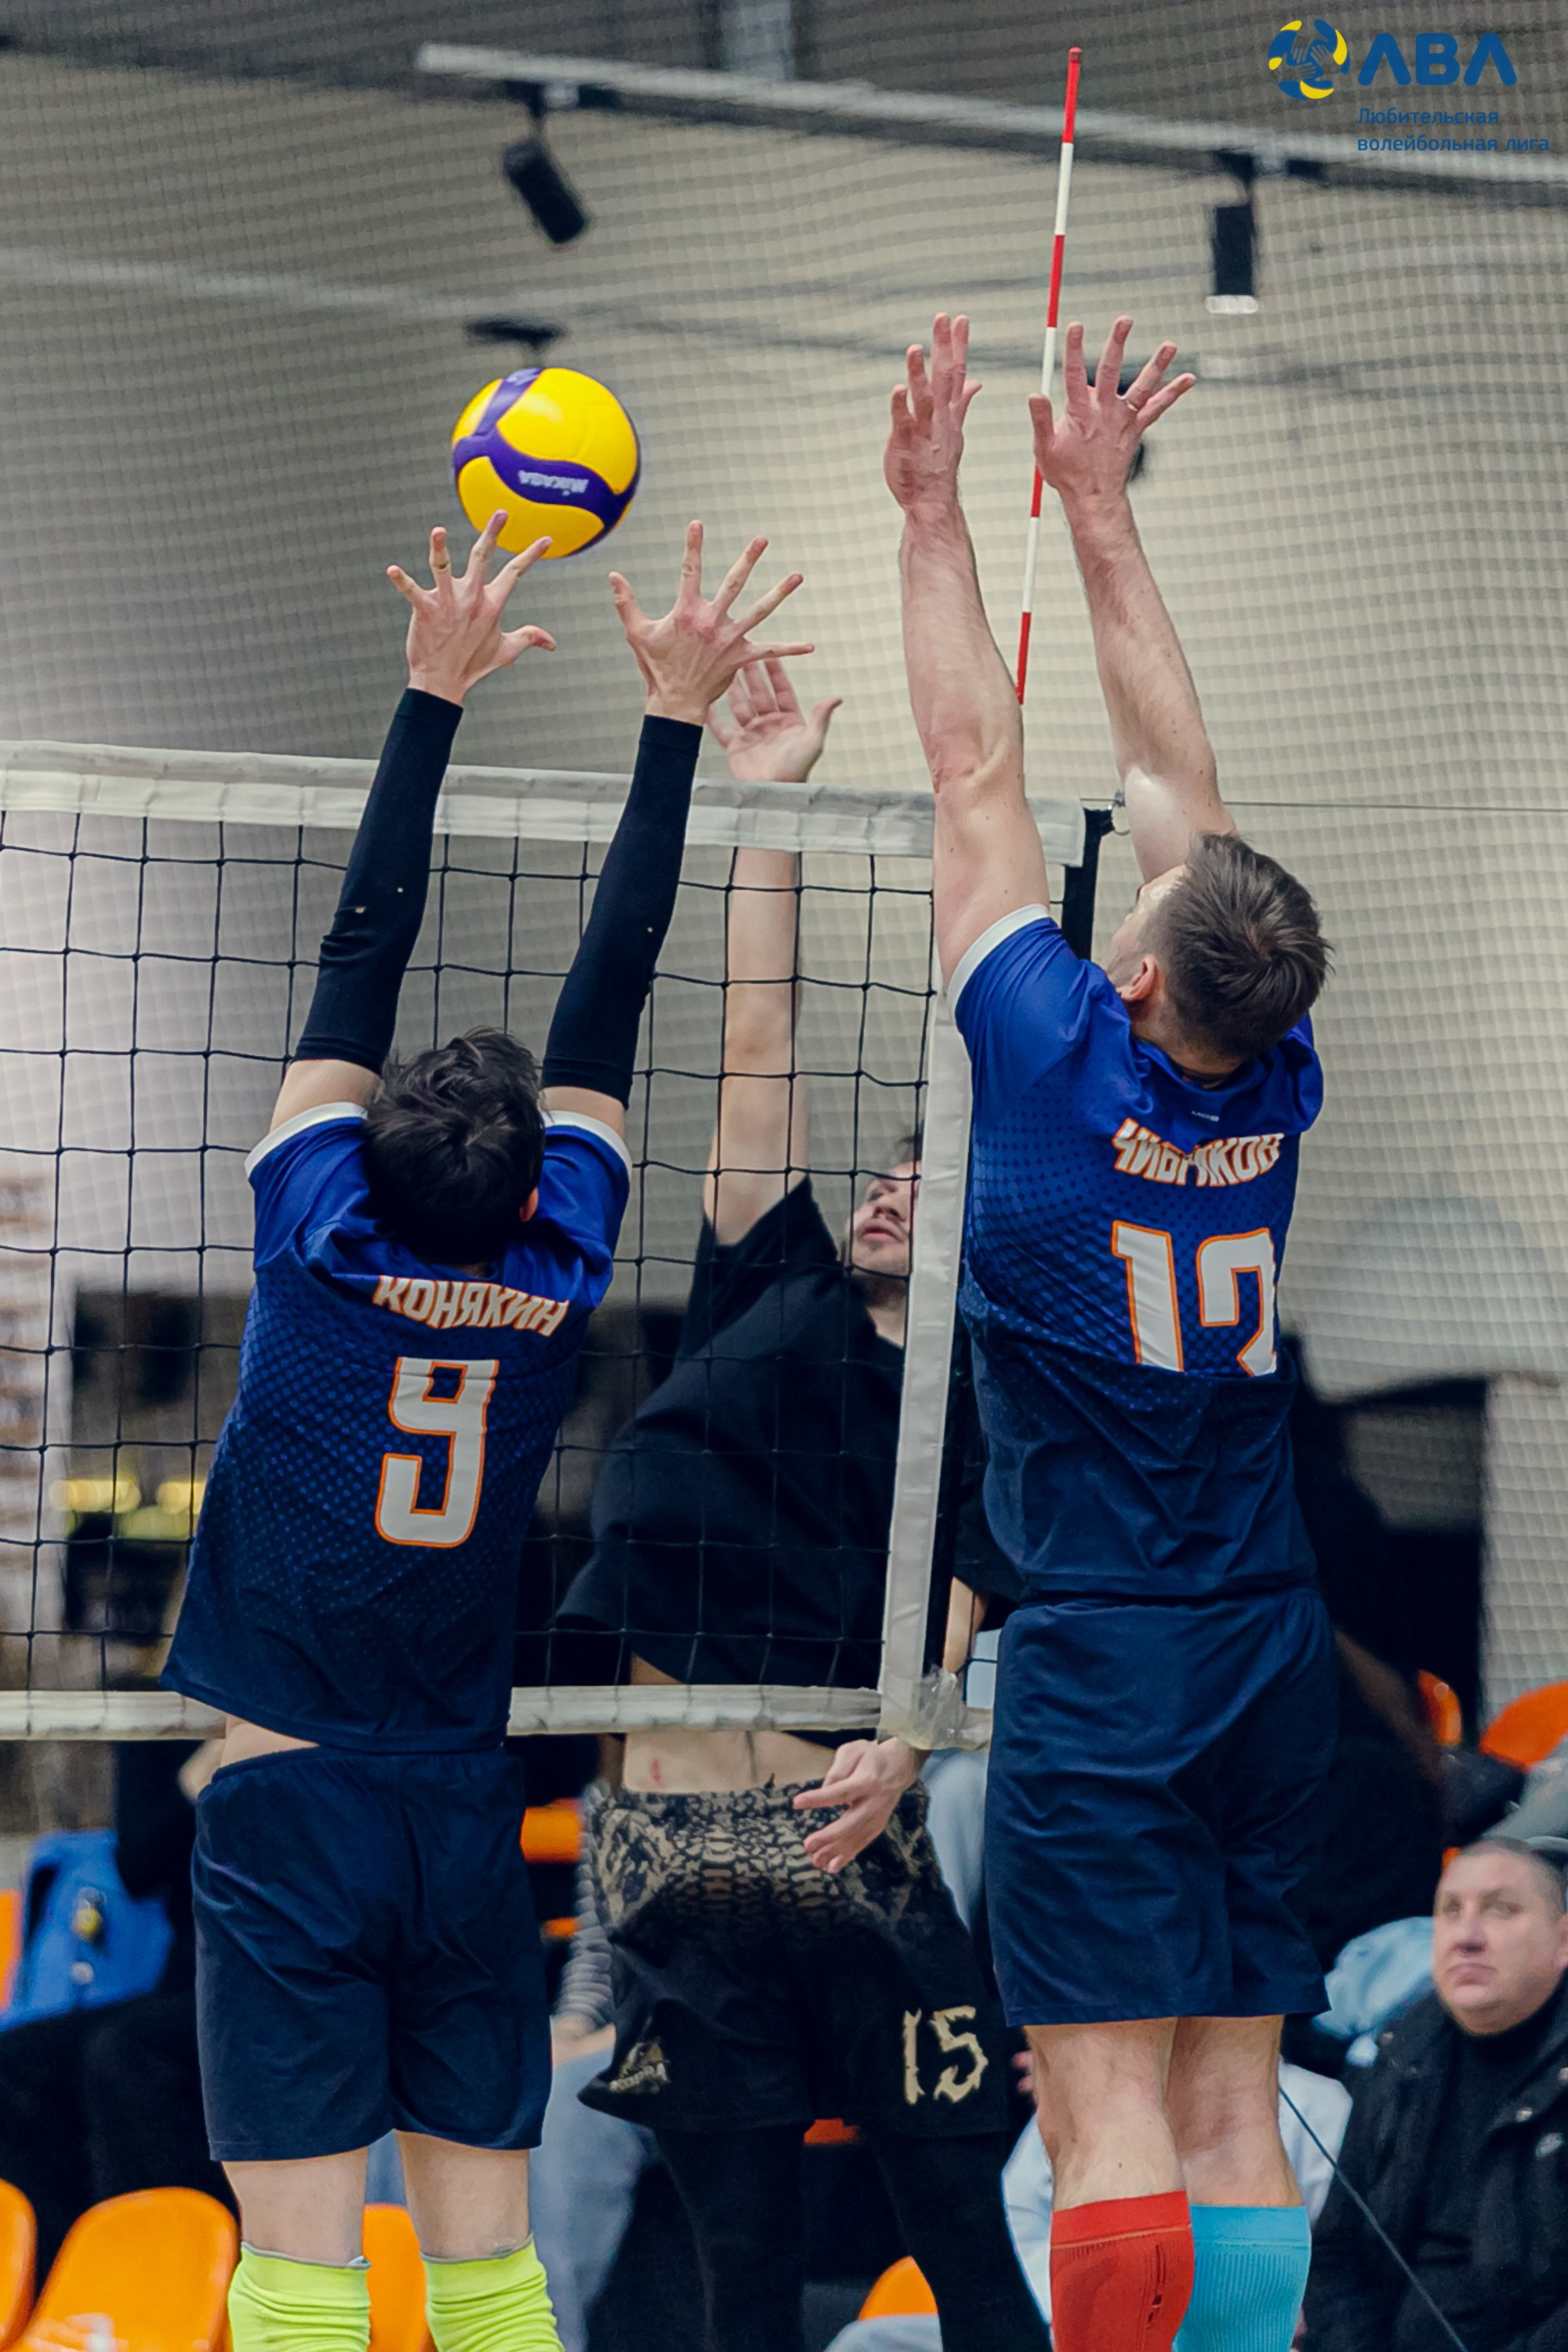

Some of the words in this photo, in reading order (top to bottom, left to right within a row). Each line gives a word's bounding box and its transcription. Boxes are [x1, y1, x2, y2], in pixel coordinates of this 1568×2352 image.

[372, 1275, 570, 1337] КОНЯХИН
[374, 1356, 499, 1548] 9
[903, 2004, 989, 2105] 15
